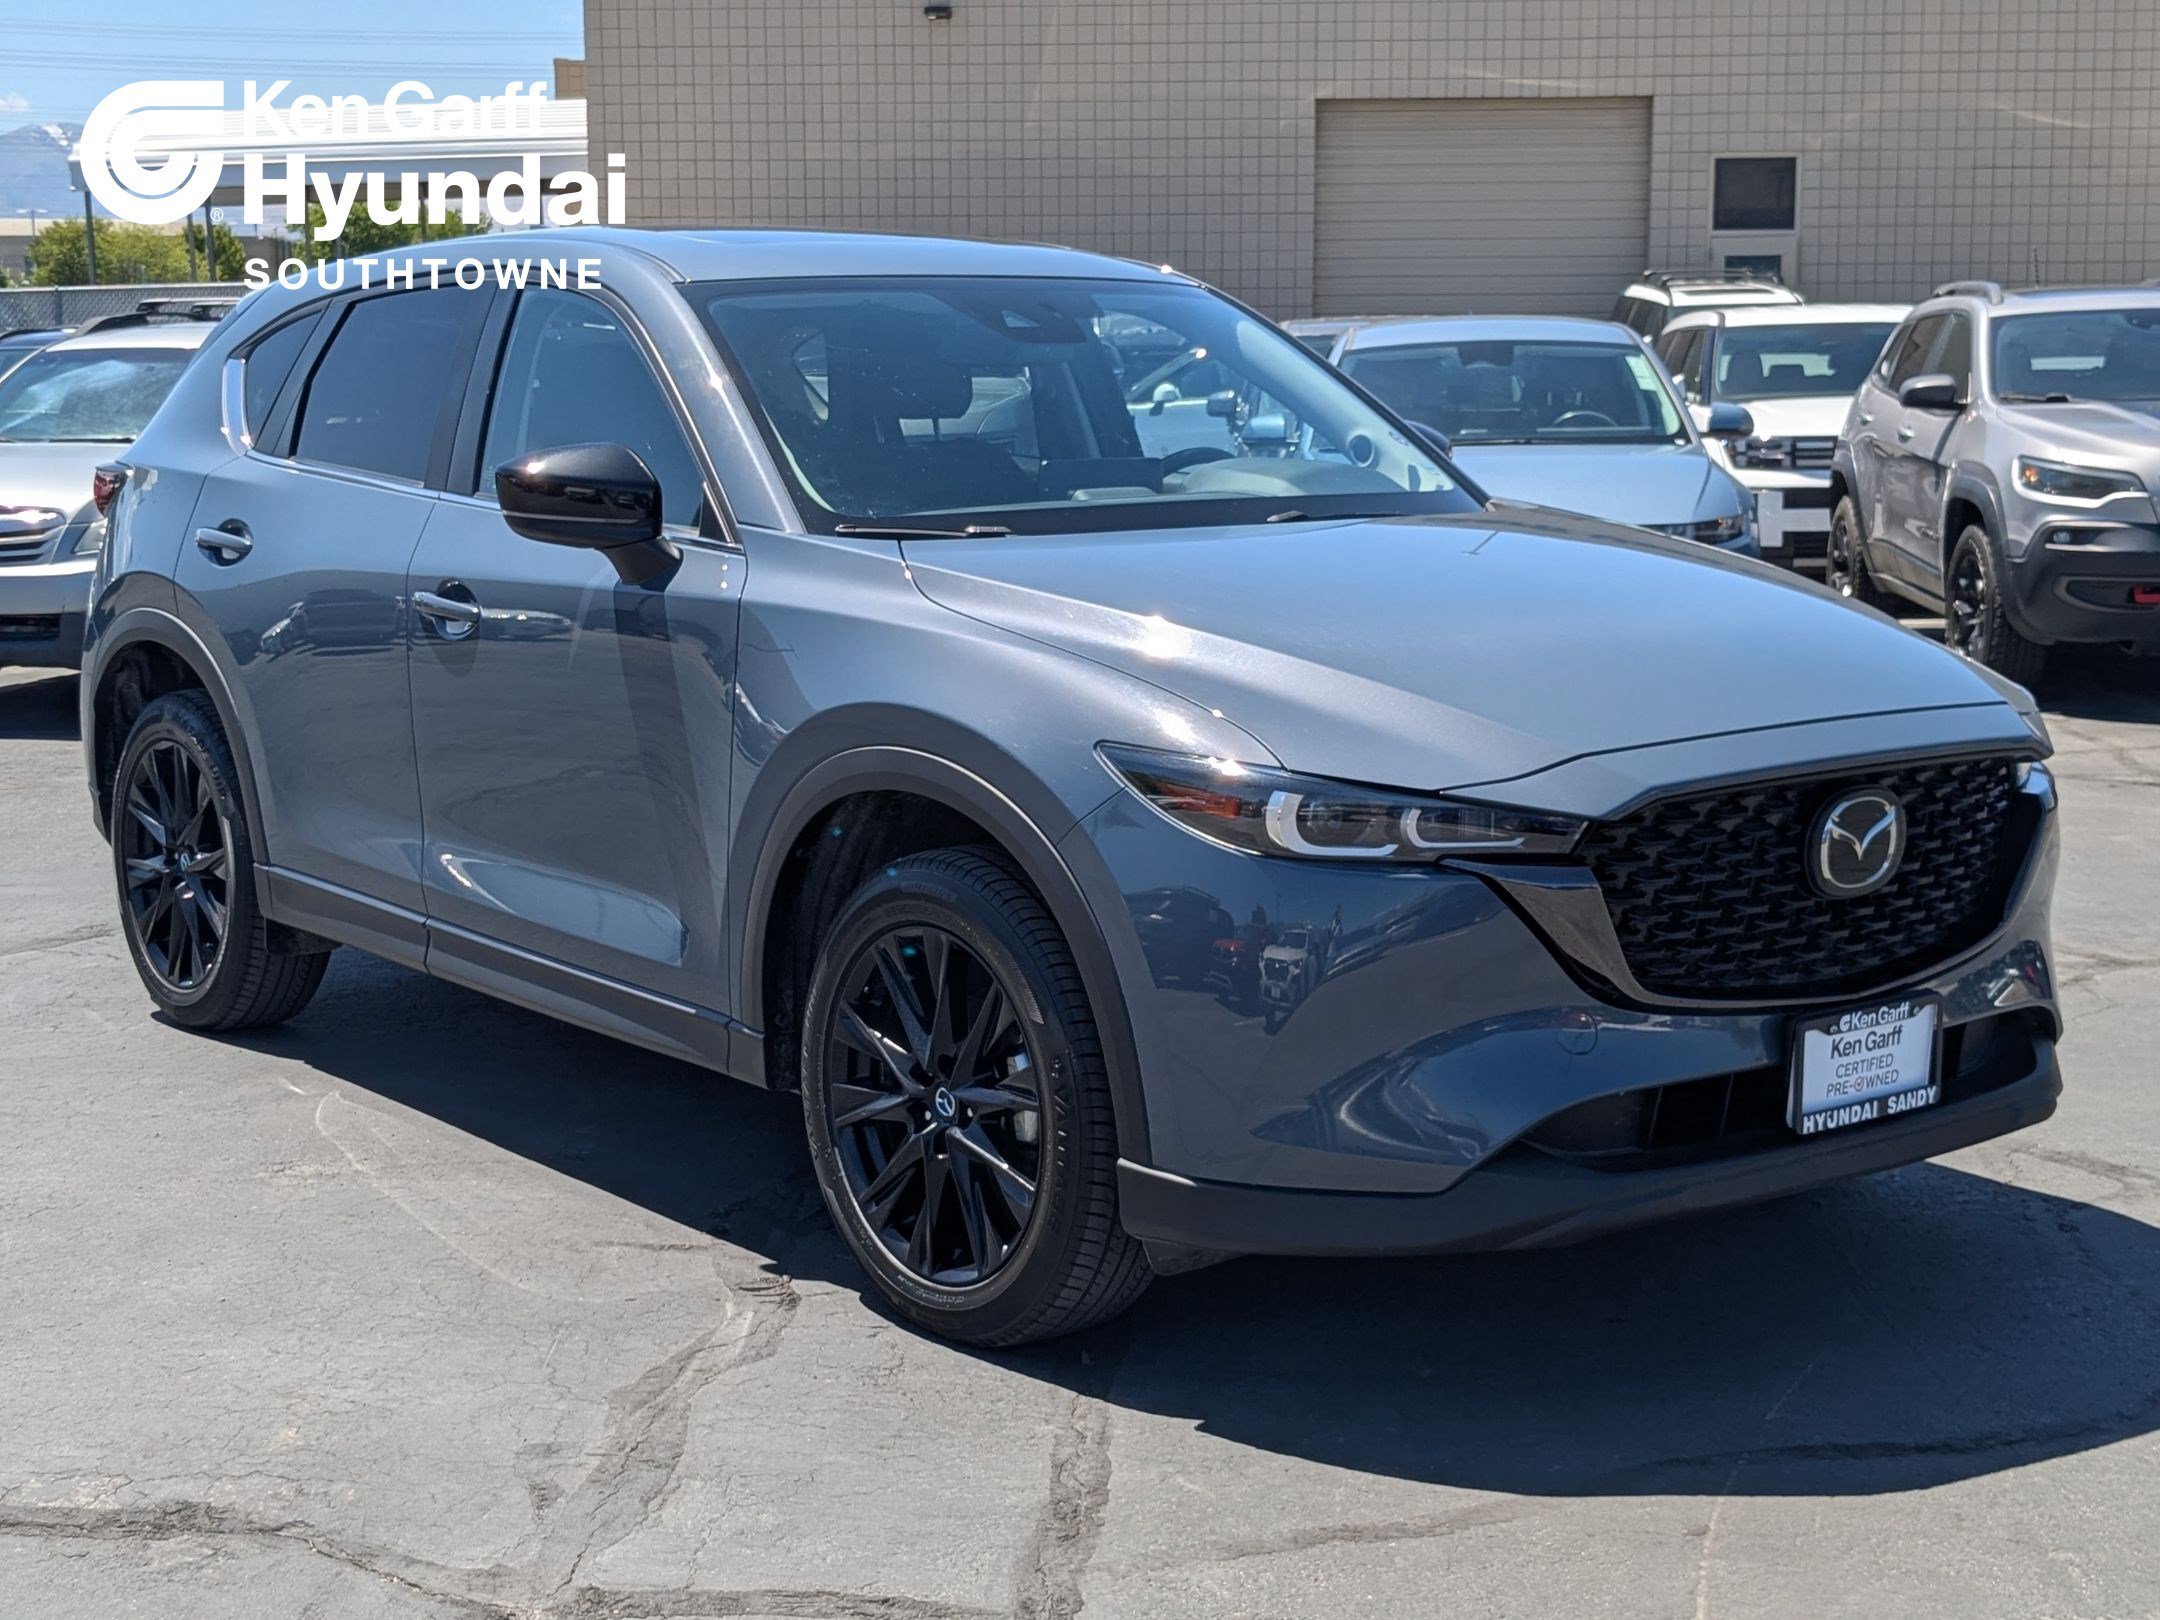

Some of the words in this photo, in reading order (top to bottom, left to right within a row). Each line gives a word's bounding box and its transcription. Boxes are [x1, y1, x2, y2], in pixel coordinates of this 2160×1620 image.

[1851, 1009, 1877, 1029] Ken
[1877, 1001, 1910, 1023] Garff
[1830, 1036, 1862, 1059] Ken
[1864, 1025, 1903, 1052] Garff
[1835, 1053, 1894, 1078] CERTIFIED
[1802, 1100, 1879, 1134] HYUNDAI
[1887, 1085, 1937, 1114] SANDY
